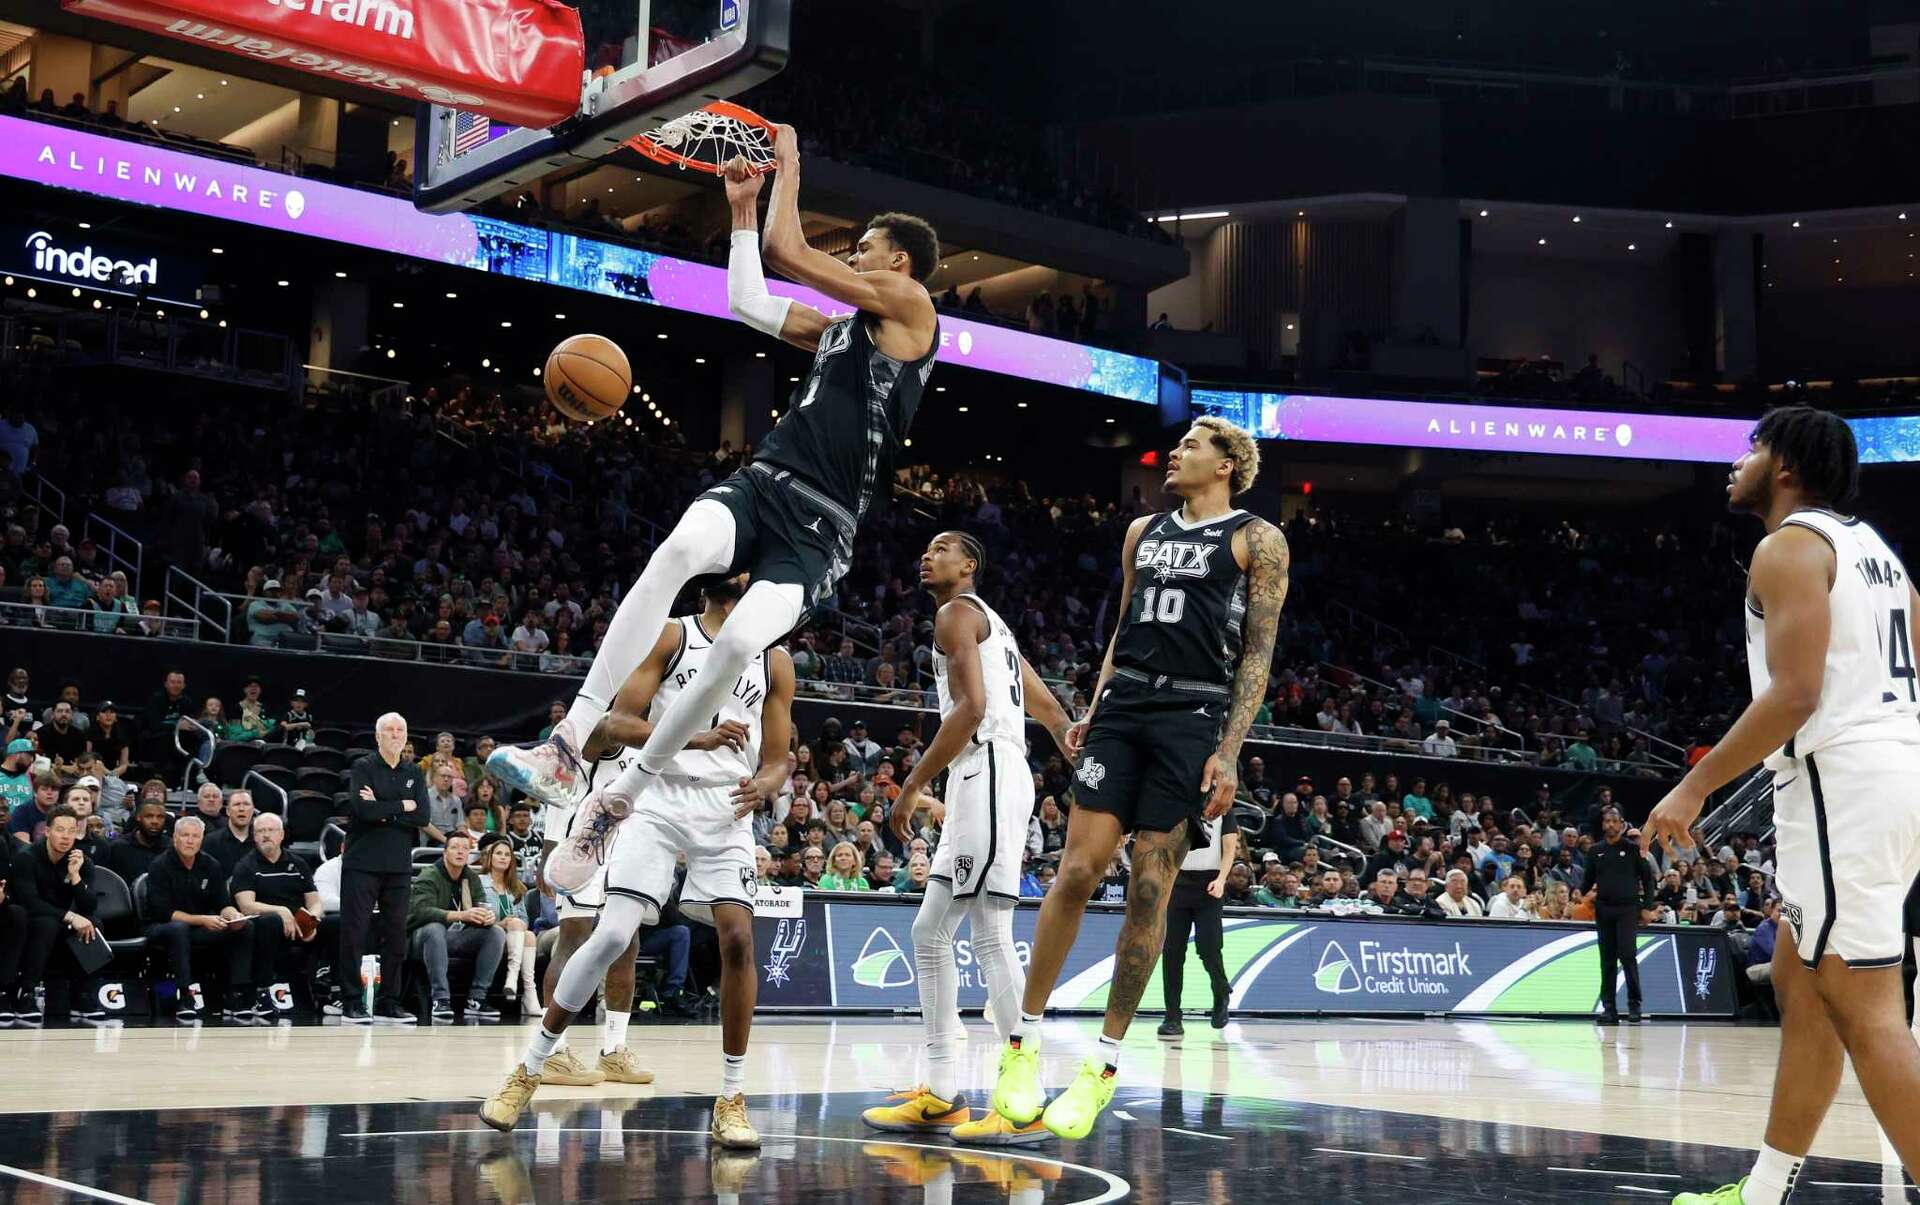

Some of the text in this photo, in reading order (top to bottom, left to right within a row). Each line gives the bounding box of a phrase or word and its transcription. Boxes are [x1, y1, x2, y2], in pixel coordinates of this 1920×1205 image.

[38, 145, 274, 209] ALIENWARE
[1427, 418, 1607, 442] ALIENWARE
[1135, 539, 1219, 580] SATX
[1139, 586, 1186, 623] 10
[1359, 940, 1473, 976] Firstmark
[1364, 976, 1406, 994] Credit
